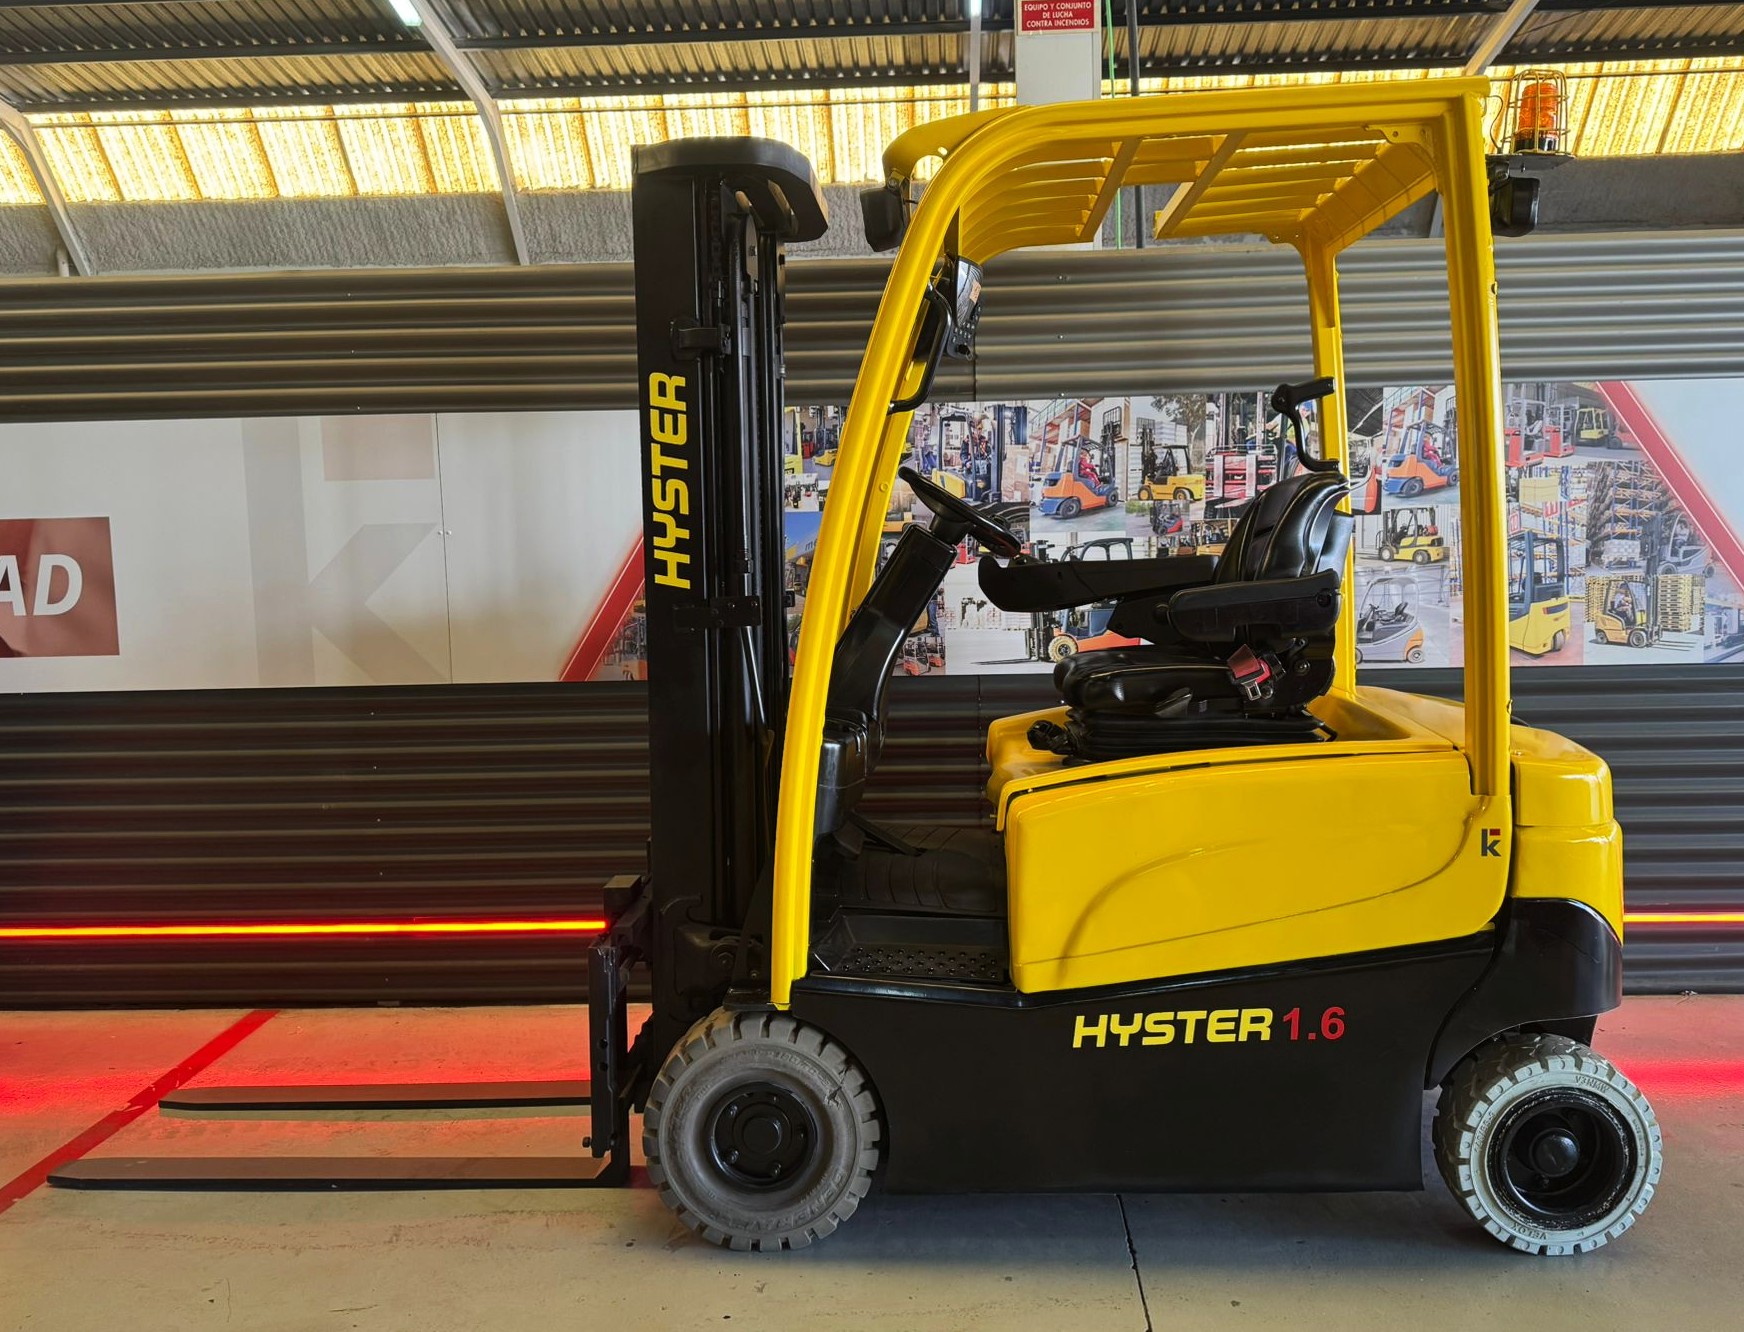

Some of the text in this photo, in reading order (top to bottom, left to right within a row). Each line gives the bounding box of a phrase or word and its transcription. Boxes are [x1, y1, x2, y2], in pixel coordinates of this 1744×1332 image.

[1024, 3, 1049, 11] EQUIPO
[1055, 2, 1092, 10] CONJUNTO
[1042, 11, 1051, 19] DE
[1026, 18, 1090, 28] CONTRA INCENDIOS
[649, 371, 691, 590] HYSTER
[1072, 1006, 1346, 1048] HYSTER 1.6
